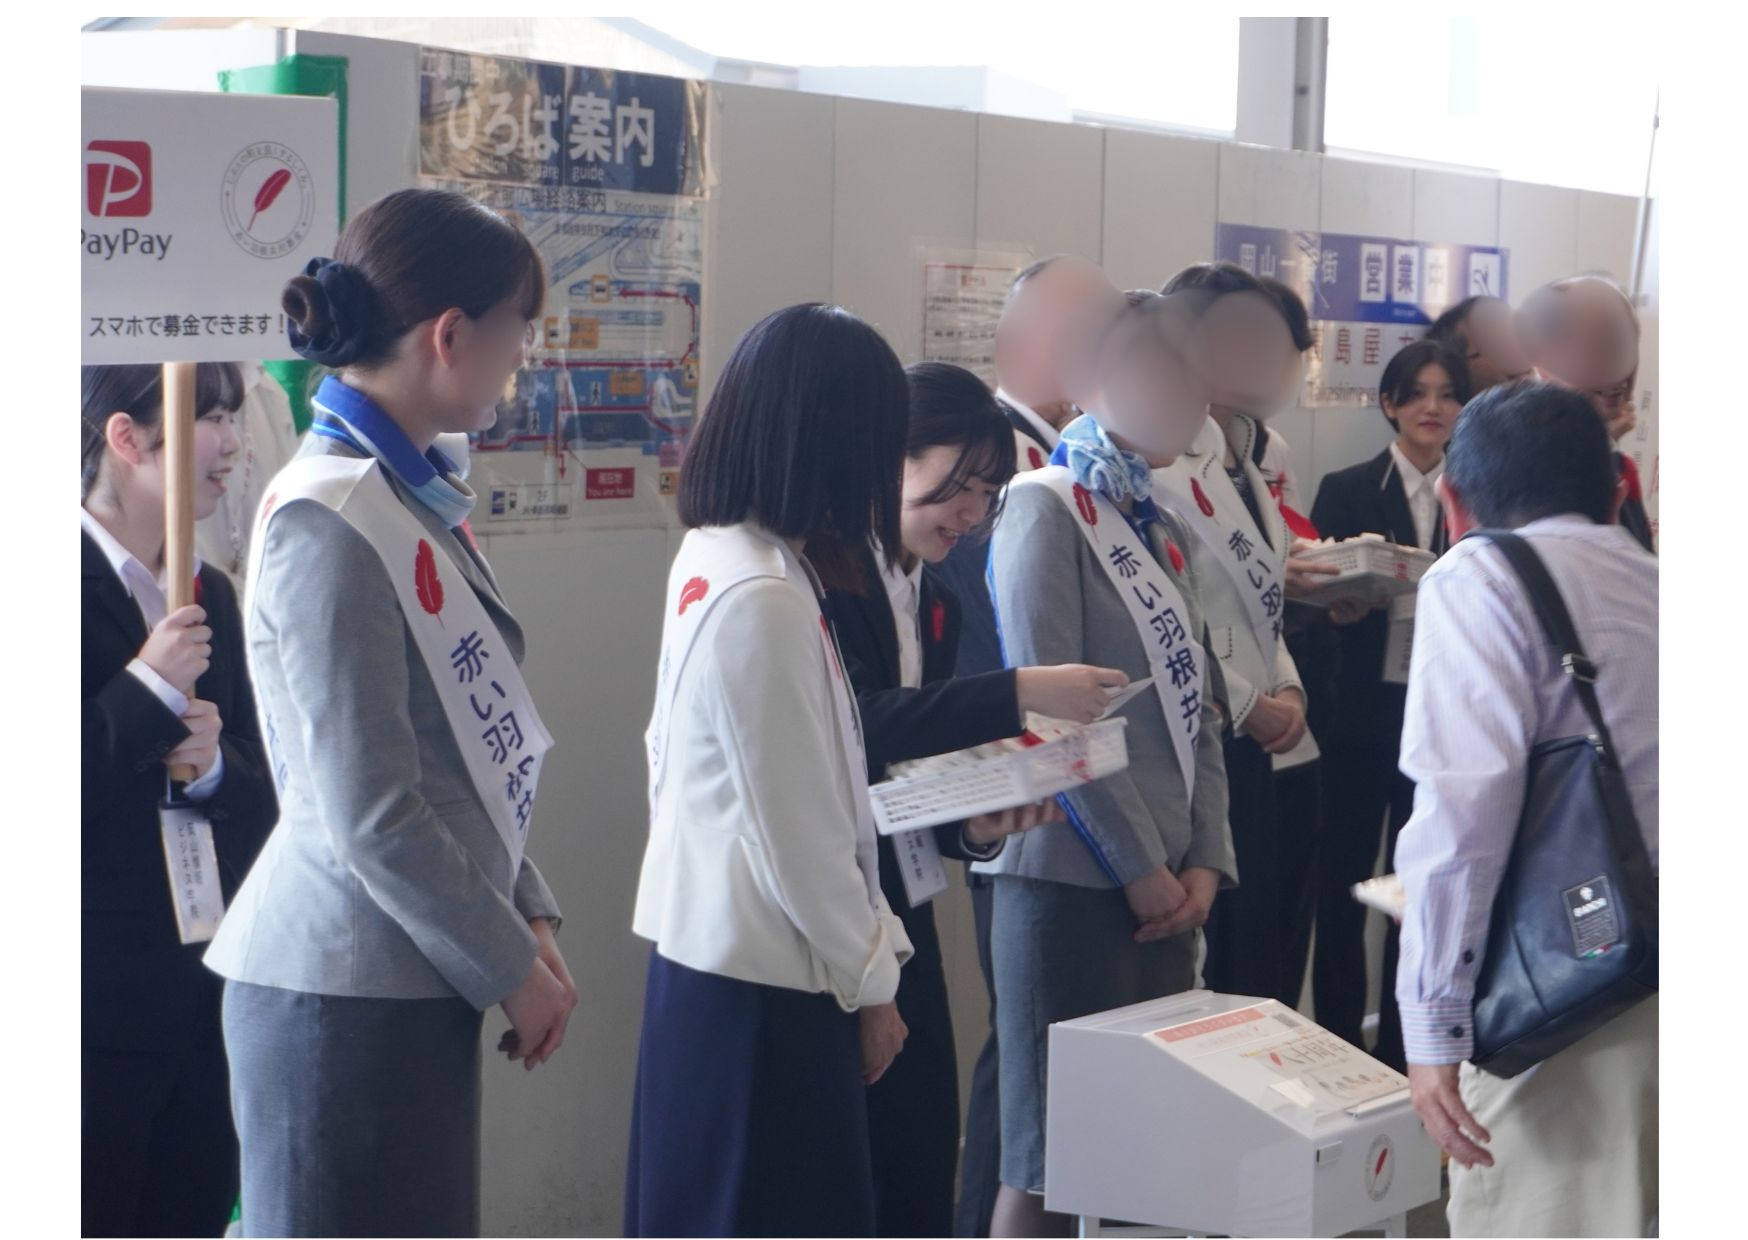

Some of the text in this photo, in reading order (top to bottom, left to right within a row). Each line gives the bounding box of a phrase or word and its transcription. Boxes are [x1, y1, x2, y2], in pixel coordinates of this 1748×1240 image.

[445, 86, 656, 168] ひろば案内
[571, 165, 605, 182] guide
[1240, 243, 1338, 284] 岡山一街
[89, 313, 285, 338] スマホで募金できます！
[1109, 544, 1199, 752] 赤い羽根共
